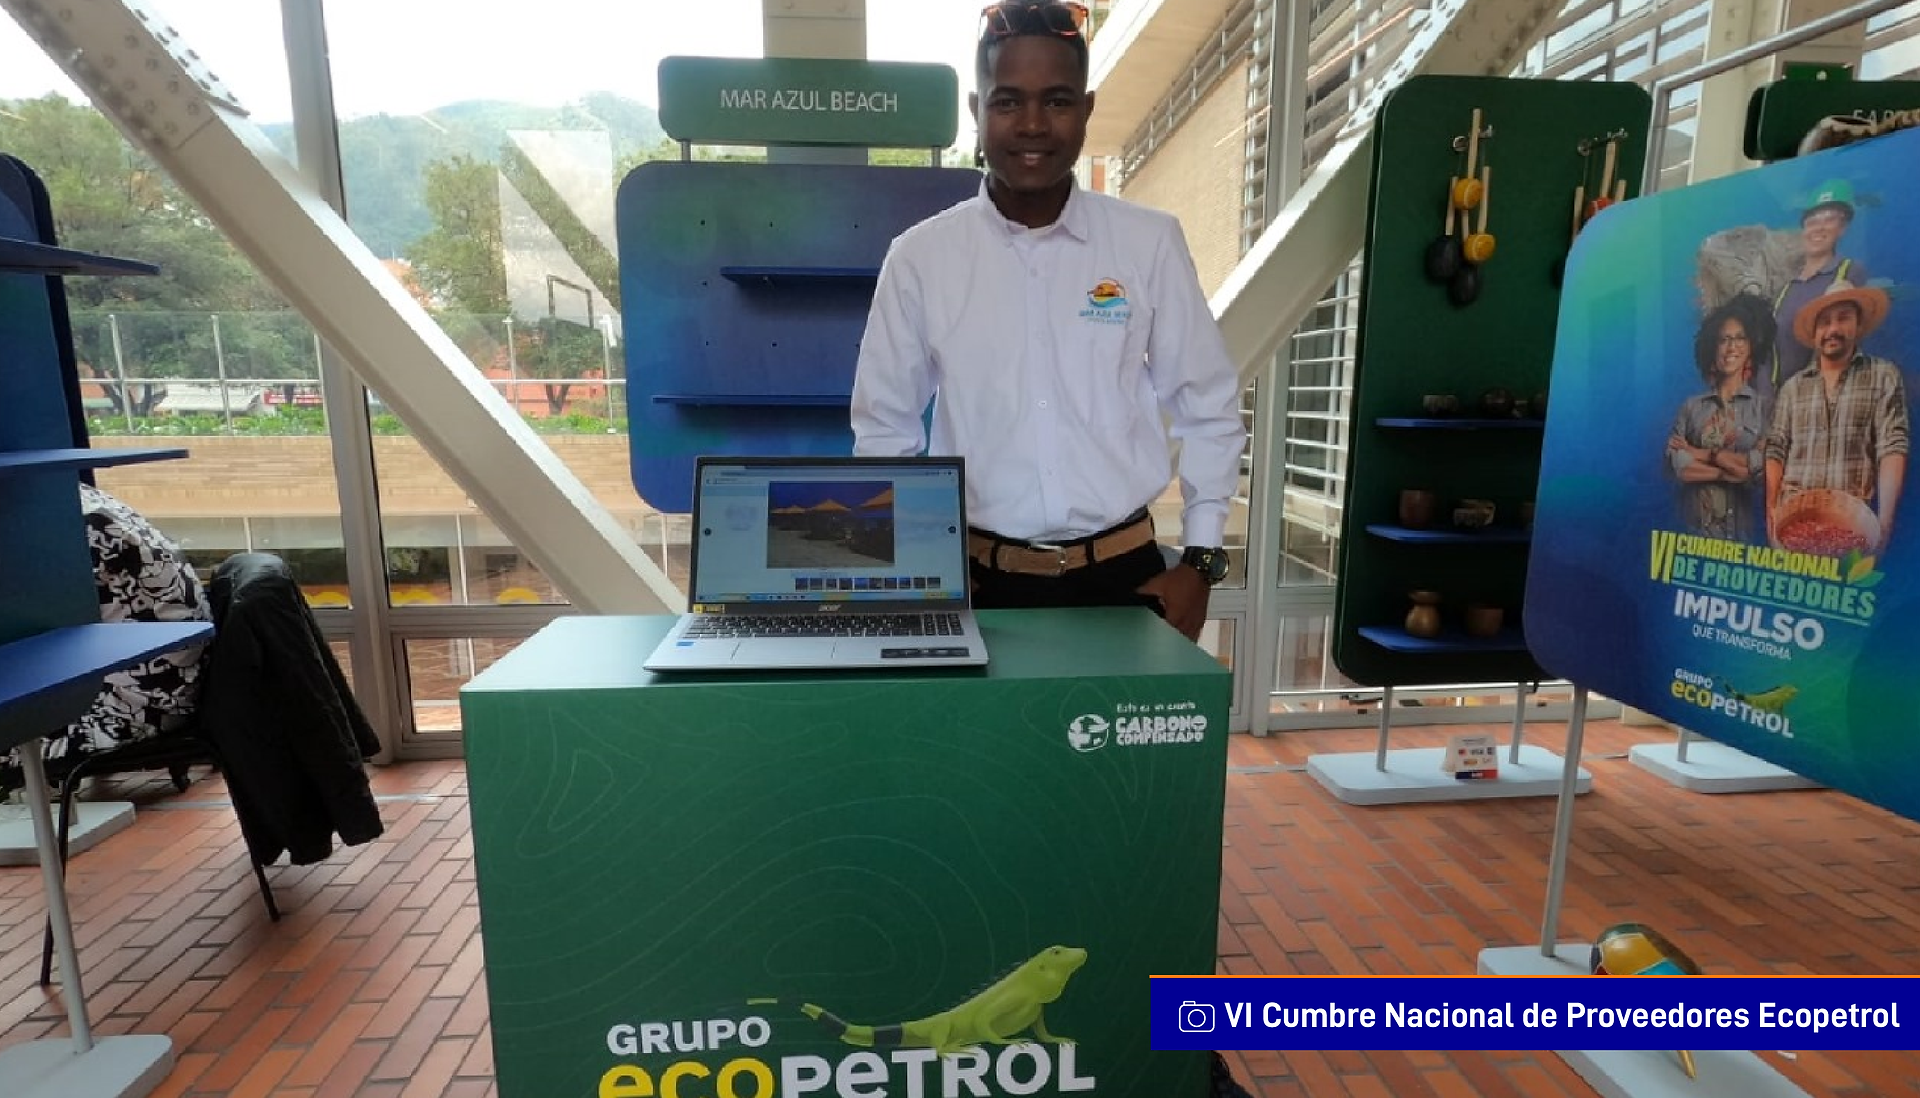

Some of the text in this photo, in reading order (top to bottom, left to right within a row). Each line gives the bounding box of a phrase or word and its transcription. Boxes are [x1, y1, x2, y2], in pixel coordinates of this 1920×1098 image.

[720, 89, 898, 113] MAR AZUL BEACH
[1651, 530, 1677, 584] VI
[1676, 535, 1843, 582] CUMBRE NACIONAL
[1673, 554, 1877, 619] DE PROVEEDORES
[1674, 589, 1825, 651] IMPULSO
[1692, 623, 1792, 661] QUE TRANSFORMA
[1674, 667, 1714, 690] GRUPO
[1115, 714, 1208, 734] CARBONO
[1116, 731, 1205, 746] COMPENSADO
[606, 1017, 772, 1056] GRUPO
